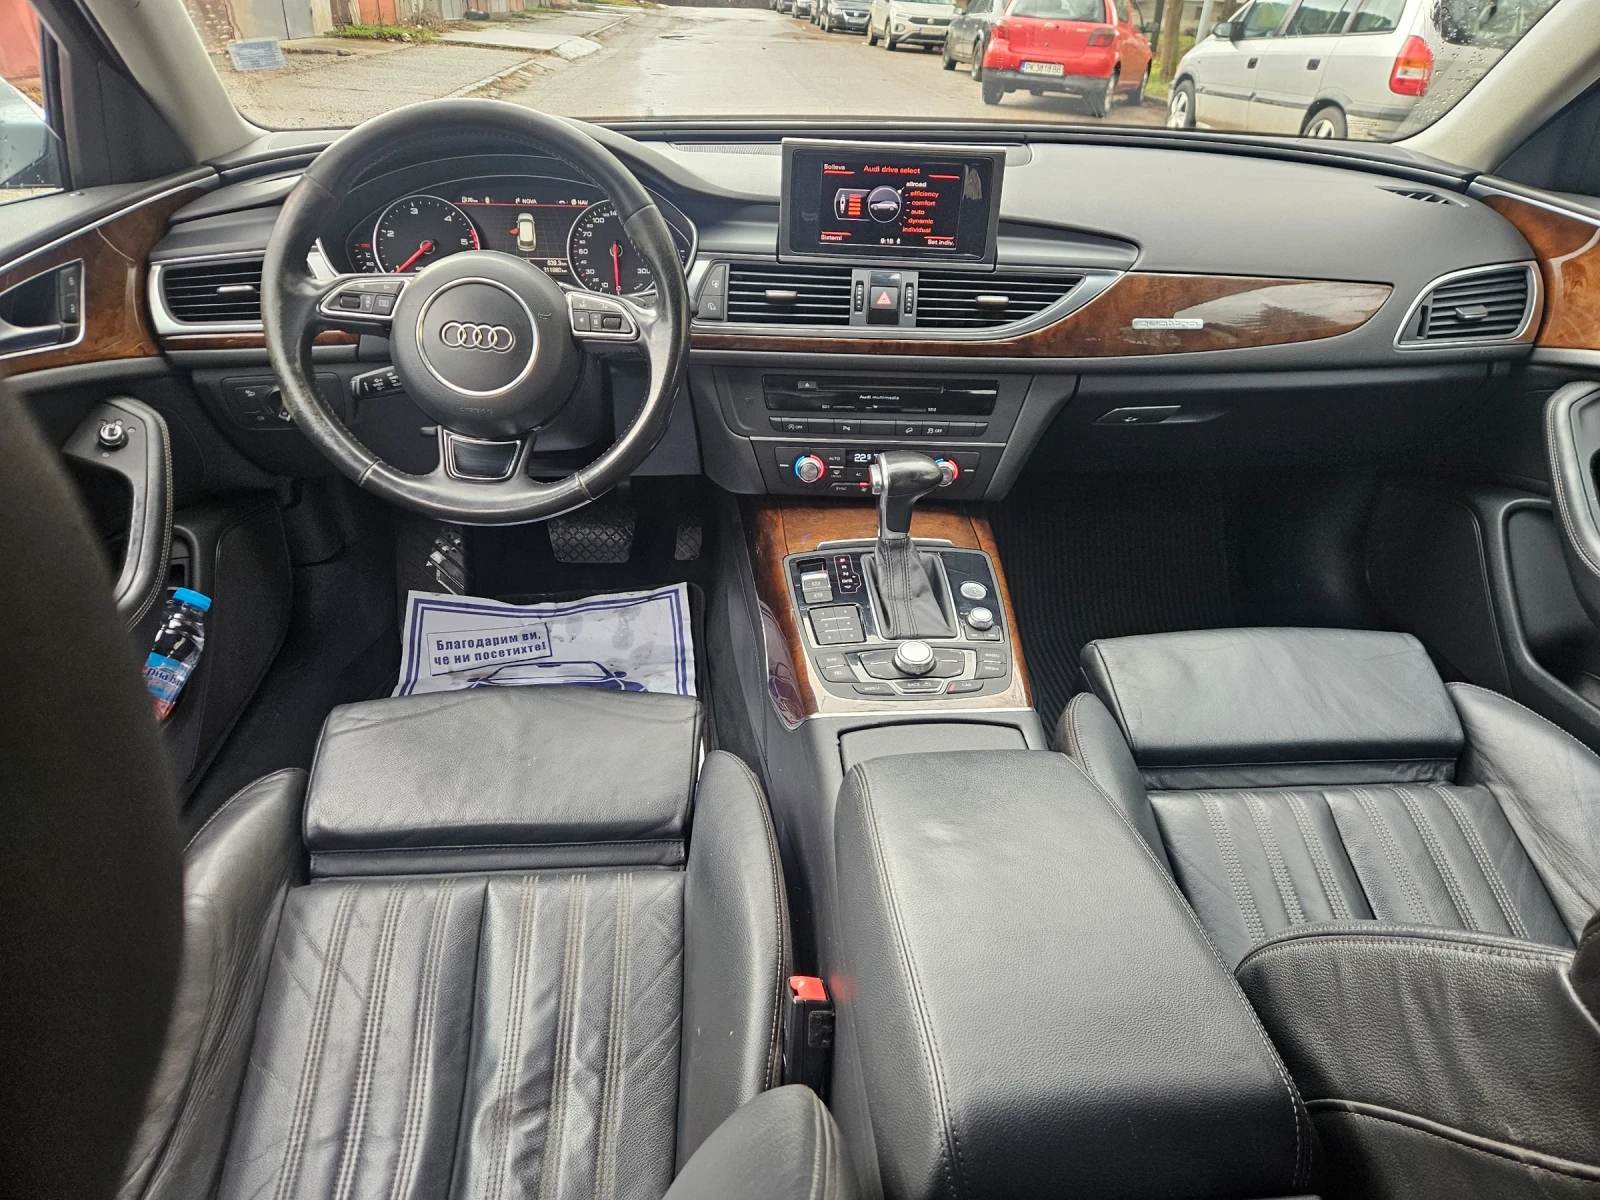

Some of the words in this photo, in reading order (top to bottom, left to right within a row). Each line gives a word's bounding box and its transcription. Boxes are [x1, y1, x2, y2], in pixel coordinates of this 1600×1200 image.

[863, 165, 880, 173] Audi
[900, 166, 921, 174] select
[910, 190, 939, 198] efficiency
[410, 207, 419, 215] 3
[386, 230, 395, 238] 2
[460, 238, 469, 246] 5
[436, 635, 518, 651] Благодарим
[434, 656, 450, 666] че
[454, 653, 471, 664] ни
[474, 641, 547, 662] посетихте!
